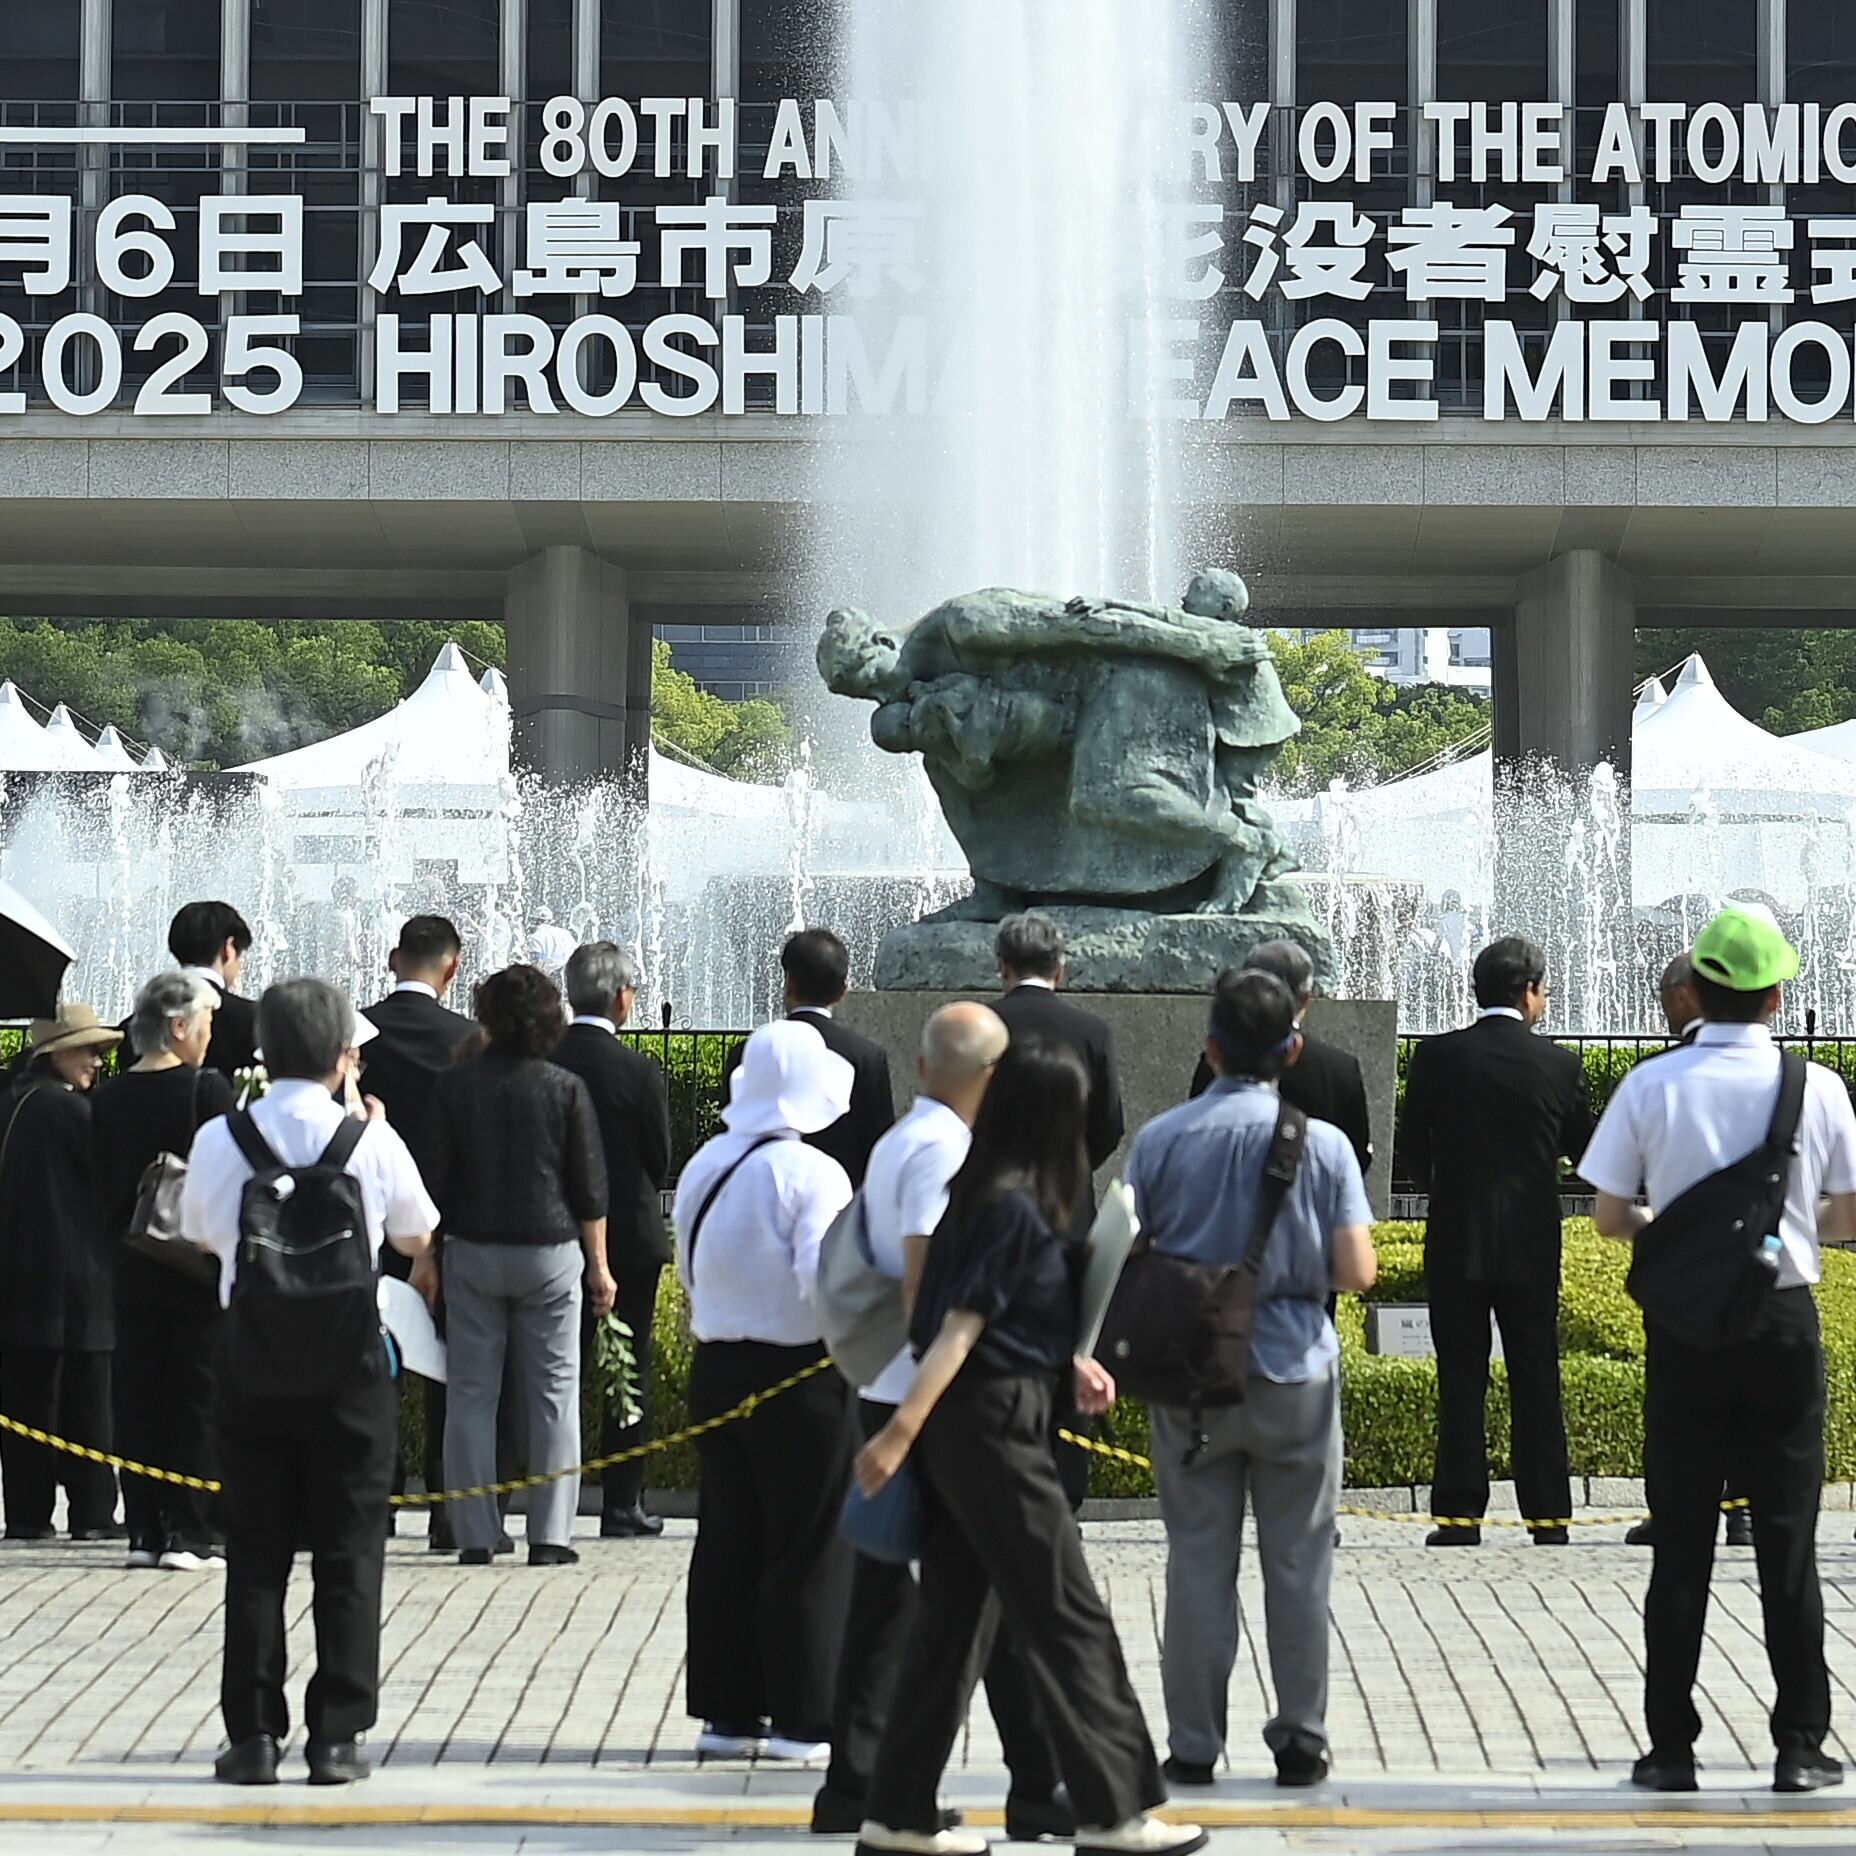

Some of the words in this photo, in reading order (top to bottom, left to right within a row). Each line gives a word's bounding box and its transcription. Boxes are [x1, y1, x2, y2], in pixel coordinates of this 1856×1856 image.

[370, 97, 511, 177] THE
[540, 96, 735, 179] 80TH
[1298, 101, 1396, 183] OF
[1423, 101, 1564, 183] THE
[376, 314, 990, 416] HIROSHIM
[1129, 319, 1439, 423] EACE
